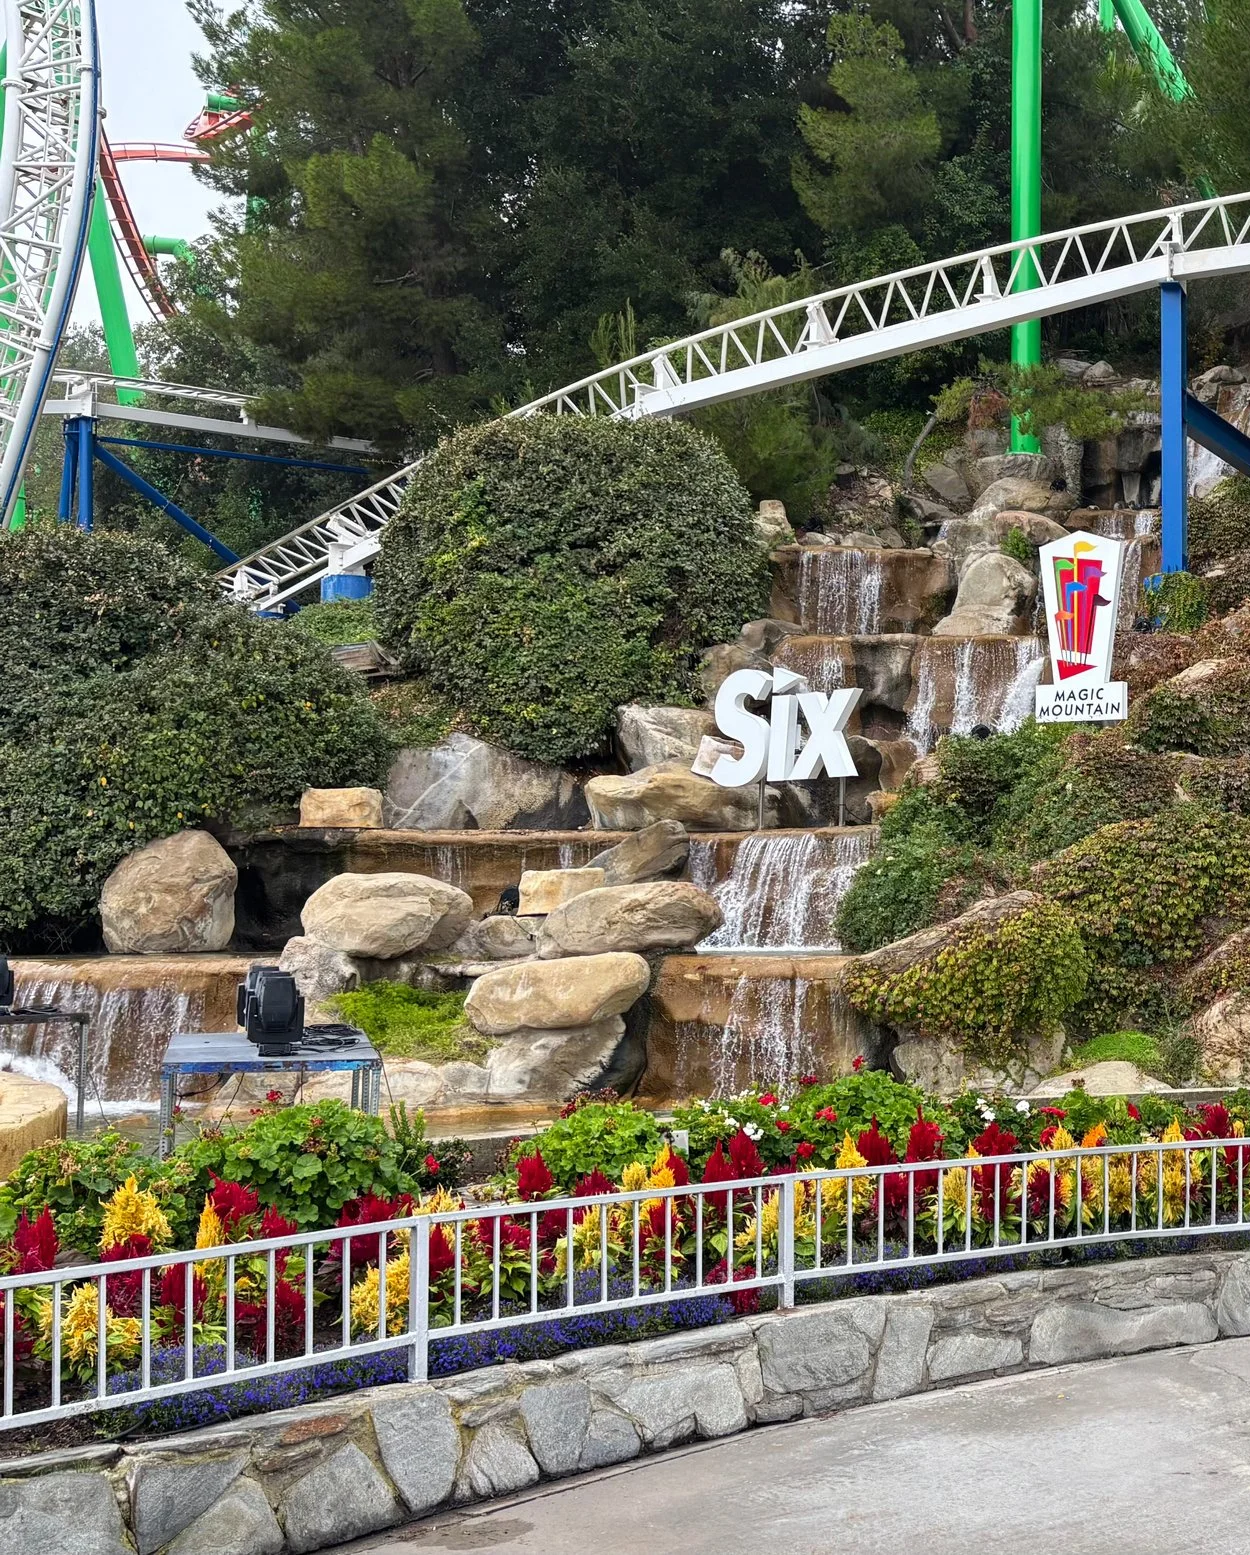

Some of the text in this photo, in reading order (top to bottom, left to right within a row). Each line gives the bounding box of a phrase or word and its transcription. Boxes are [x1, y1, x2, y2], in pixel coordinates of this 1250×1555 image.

[1054, 688, 1104, 702] MAGIC
[1039, 702, 1120, 717] MOUNTAIN
[711, 667, 863, 787] Six
